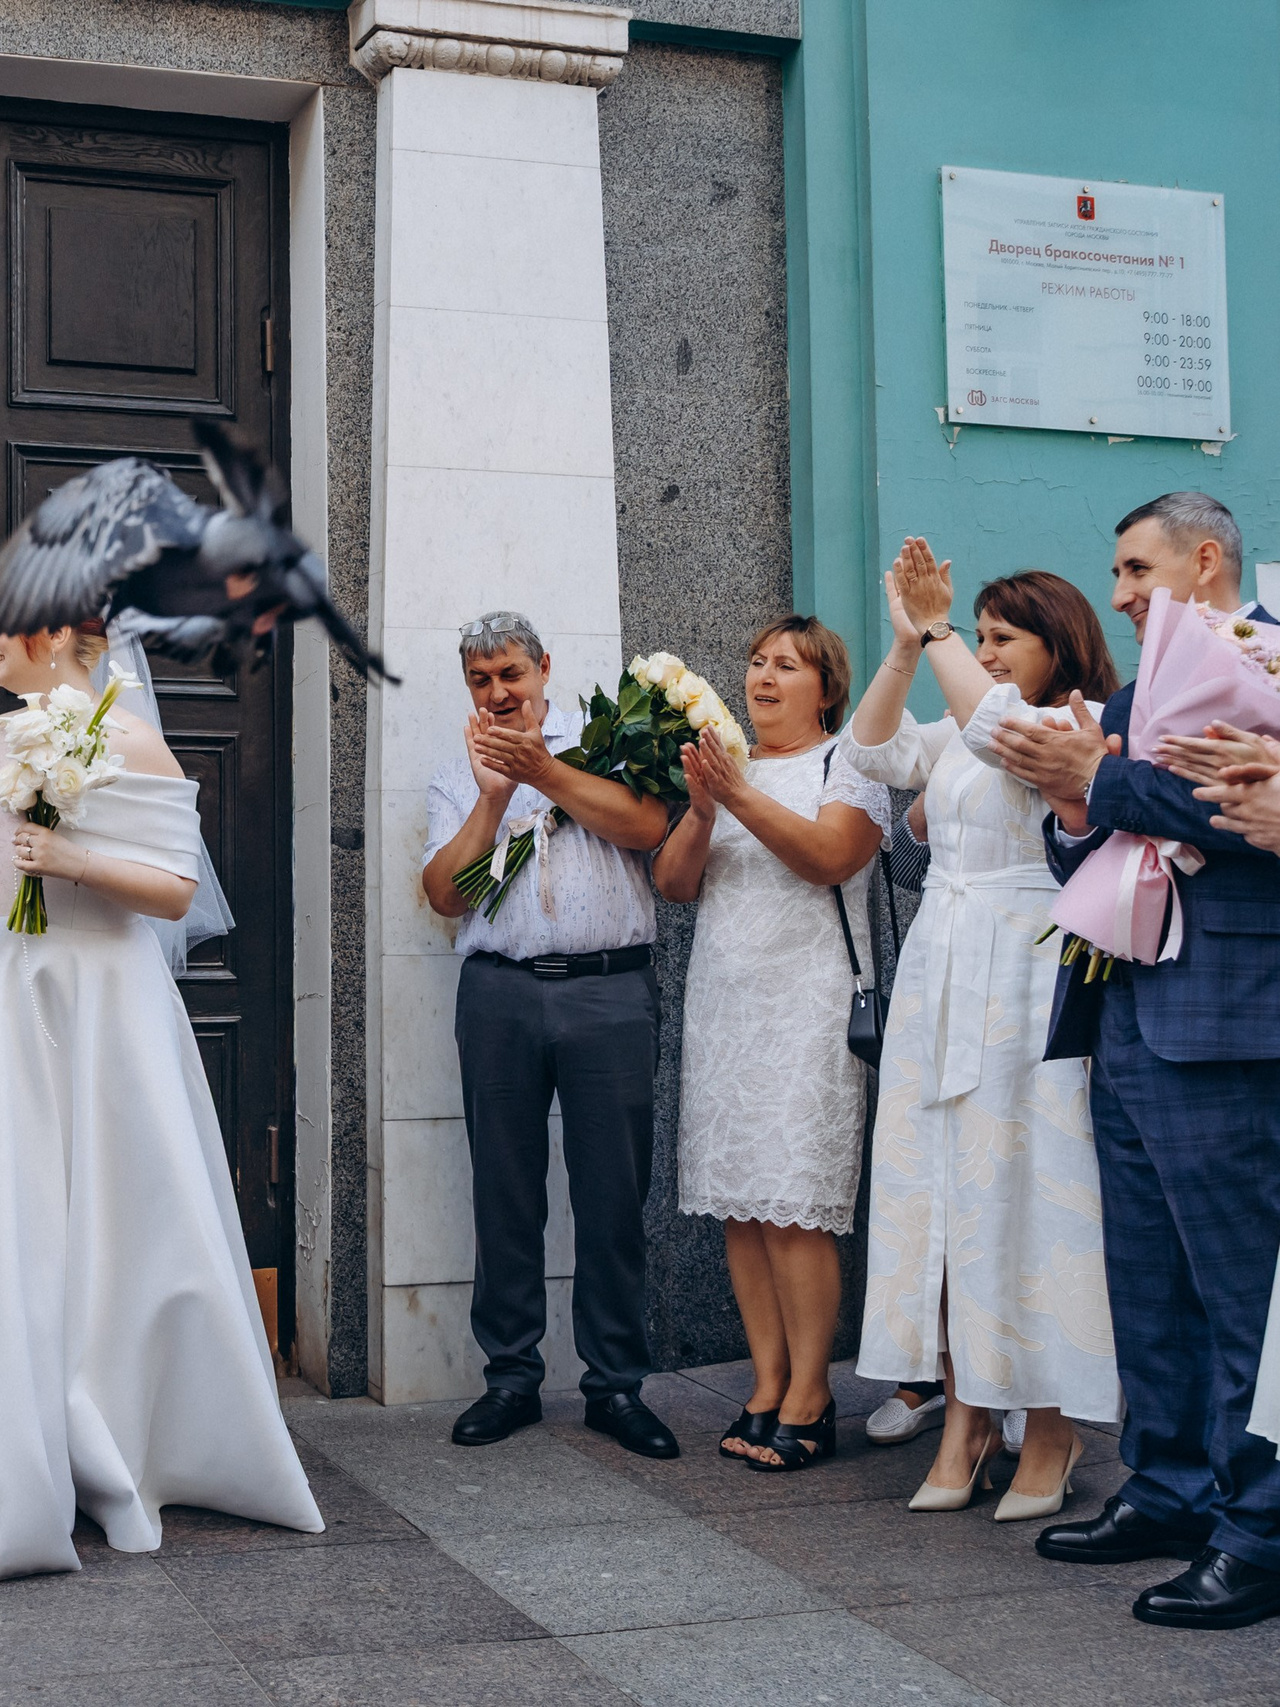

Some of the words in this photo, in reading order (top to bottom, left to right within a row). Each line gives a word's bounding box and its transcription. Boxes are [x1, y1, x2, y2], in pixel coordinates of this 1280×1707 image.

[989, 239, 1041, 258] Дворец
[1045, 244, 1154, 266] бракосочетания
[1159, 255, 1174, 268] №
[1180, 257, 1184, 269] 1
[1042, 282, 1086, 297] РЕЖИМ
[1090, 286, 1135, 301] РАБОТЫ
[964, 301, 1008, 311] ПОНЕДЕЛЬНИК
[1012, 305, 1034, 313] ЧЕТВЕРГ
[965, 323, 992, 332] ПЯТНИЦА
[1143, 311, 1168, 324] 9:00
[1181, 314, 1210, 328] 18:00
[1144, 332, 1169, 346] 9:00
[1179, 335, 1211, 349] 20:00
[1144, 354, 1170, 368] 9:00
[1180, 357, 1212, 370] 23:59
[966, 368, 1006, 377] ВОСКРЕСЕНЬЕ
[1137, 375, 1170, 389] 00:00
[1182, 378, 1212, 392] 19:00
[1009, 397, 1040, 405] МОСКВЫ
